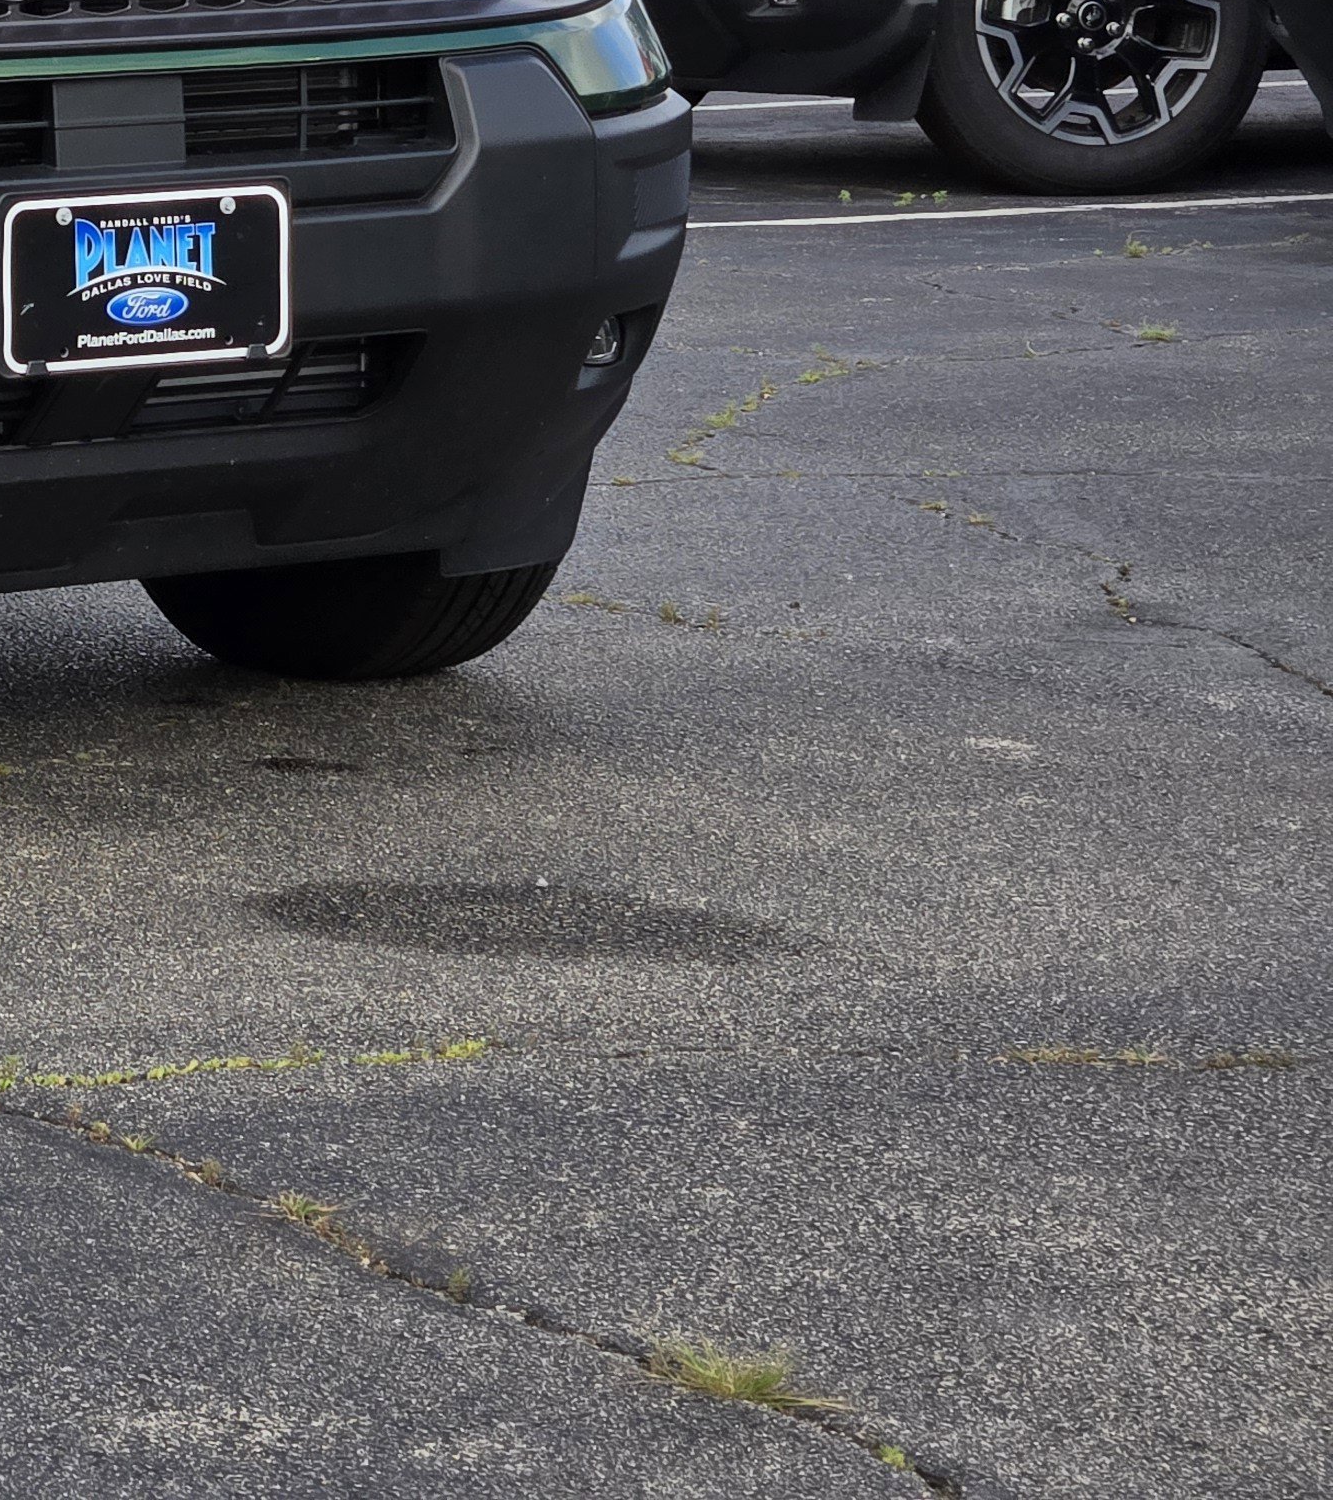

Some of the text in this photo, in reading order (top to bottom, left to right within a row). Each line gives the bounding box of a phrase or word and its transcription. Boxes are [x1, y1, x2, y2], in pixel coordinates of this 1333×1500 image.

[100, 218, 149, 229] RANDALL
[74, 217, 216, 290] PLANET
[81, 273, 212, 301] DALLAS LOVE FIELD
[121, 293, 172, 319] Ford
[76, 327, 216, 348] PlanetFordDallas.com
